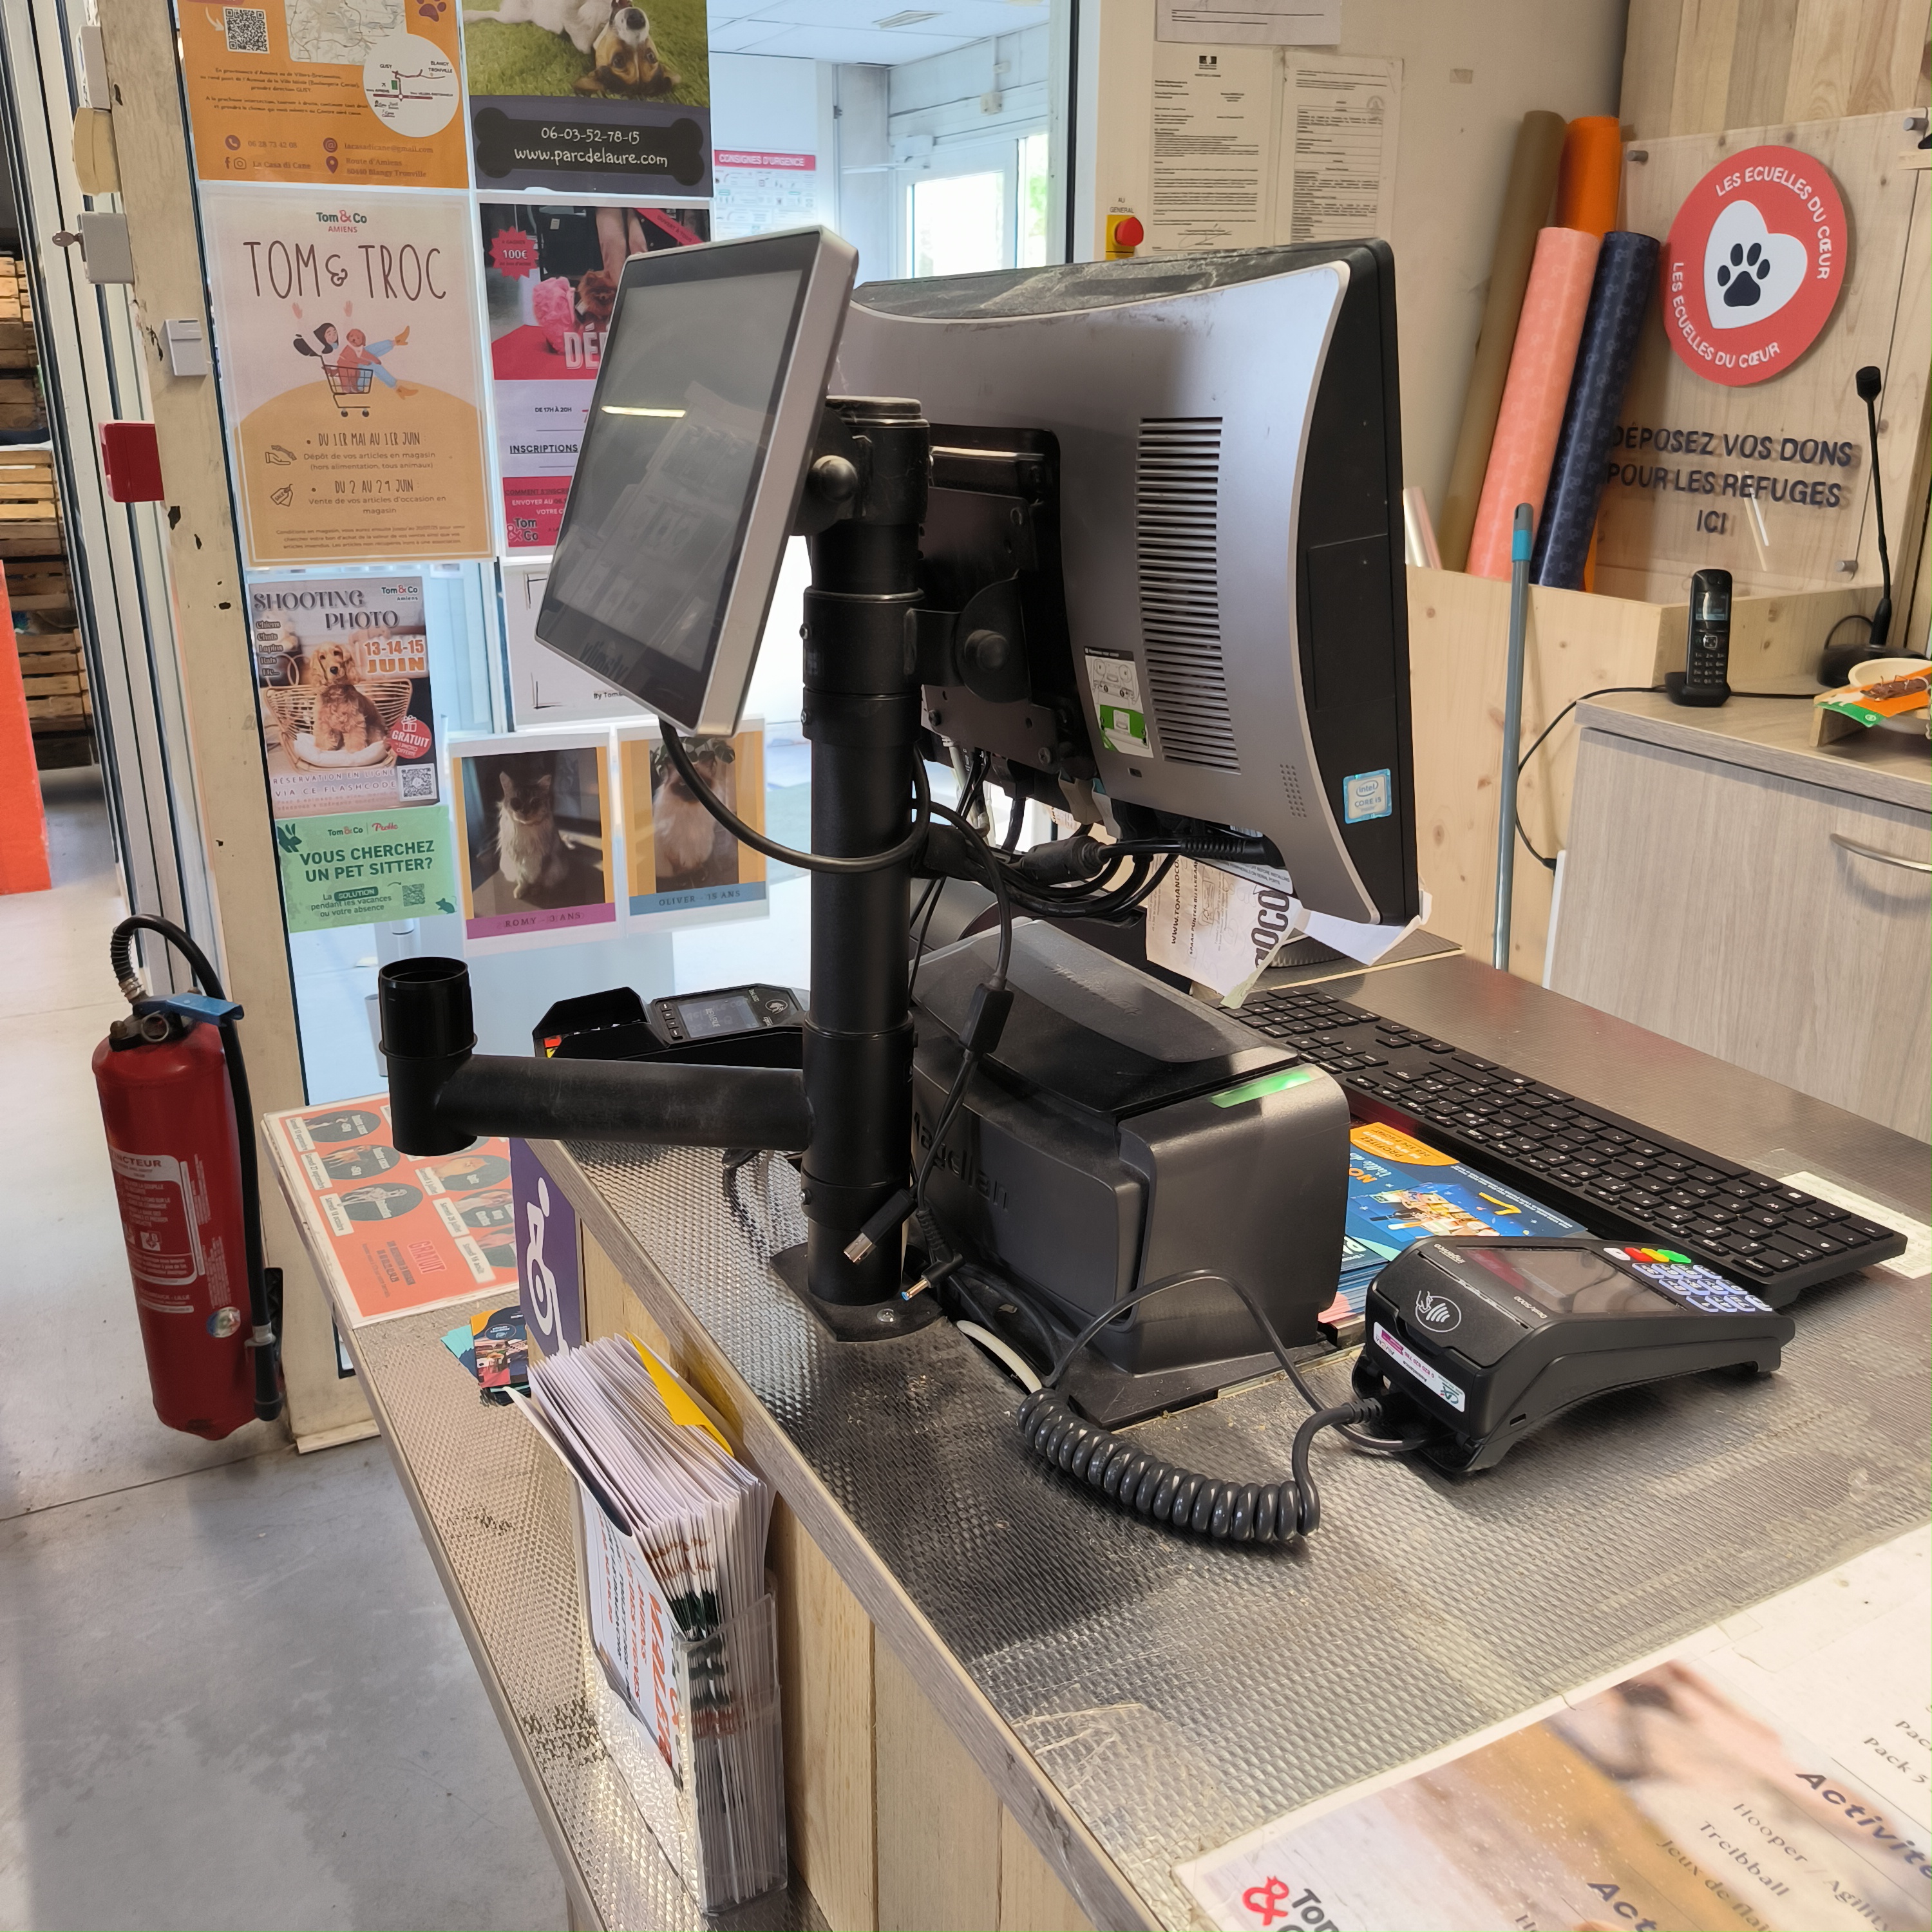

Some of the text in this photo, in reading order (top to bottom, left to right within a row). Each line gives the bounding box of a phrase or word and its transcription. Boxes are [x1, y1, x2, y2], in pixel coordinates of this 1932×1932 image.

[540, 127, 640, 145] 06-03-52-78-15
[514, 147, 668, 168] www.parcdelaure.com
[1714, 165, 1832, 281] LES ECUELLES DU CŒUR
[502, 249, 527, 260] 100€
[243, 240, 446, 301] TOM & TROC
[1671, 261, 1781, 369] LES ECUELLES DU CŒUR
[319, 433, 328, 446] DU
[352, 433, 366, 446] MAI
[370, 433, 380, 446] AU
[402, 432, 421, 445] JUIN
[509, 444, 578, 453] INSCRIPTIONS
[1722, 433, 1773, 460] VOS
[1779, 437, 1853, 468] DONS
[335, 480, 345, 494] DU
[362, 480, 372, 493] AU
[396, 479, 413, 492] JUIN
[1609, 463, 1842, 508] POUR LES REFUGES
[515, 518, 537, 529] Tom
[1696, 509, 1727, 535] ICI
[524, 531, 538, 542] Co
[254, 590, 365, 611] SHOOTING
[325, 611, 399, 630] PHOTO
[365, 639, 424, 656] 13-14-15
[367, 657, 424, 674] JUIN
[392, 730, 430, 748] GRATUIT
[324, 781, 396, 793] FLASHCODE
[1359, 783, 1375, 793] intel
[1354, 799, 1374, 807] CORE
[299, 840, 435, 866] VOUS CHERCHEZ
[305, 857, 433, 882] UN PET SITTER?
[311, 900, 342, 911] pendant
[357, 895, 392, 905] vacances
[338, 888, 375, 899] SOLUTION
[659, 895, 696, 907] OLIVER
[721, 890, 741, 900] ANS
[332, 907, 352, 916] votre
[354, 904, 384, 914] absence
[505, 916, 536, 928] ROMY
[558, 911, 581, 922] ANS
[408, 1240, 446, 1273] GRATUIT
[1433, 1243, 1466, 1264] ingenico
[1513, 1295, 1548, 1319] Desk/5000
[1895, 1720, 1932, 1752] Pac
[1864, 1737, 1912, 1773] Pack
[1732, 1803, 1809, 1863] Hooper
[1698, 1820, 1791, 1897] Treibball
[1656, 1839, 1730, 1901] Jeux de
